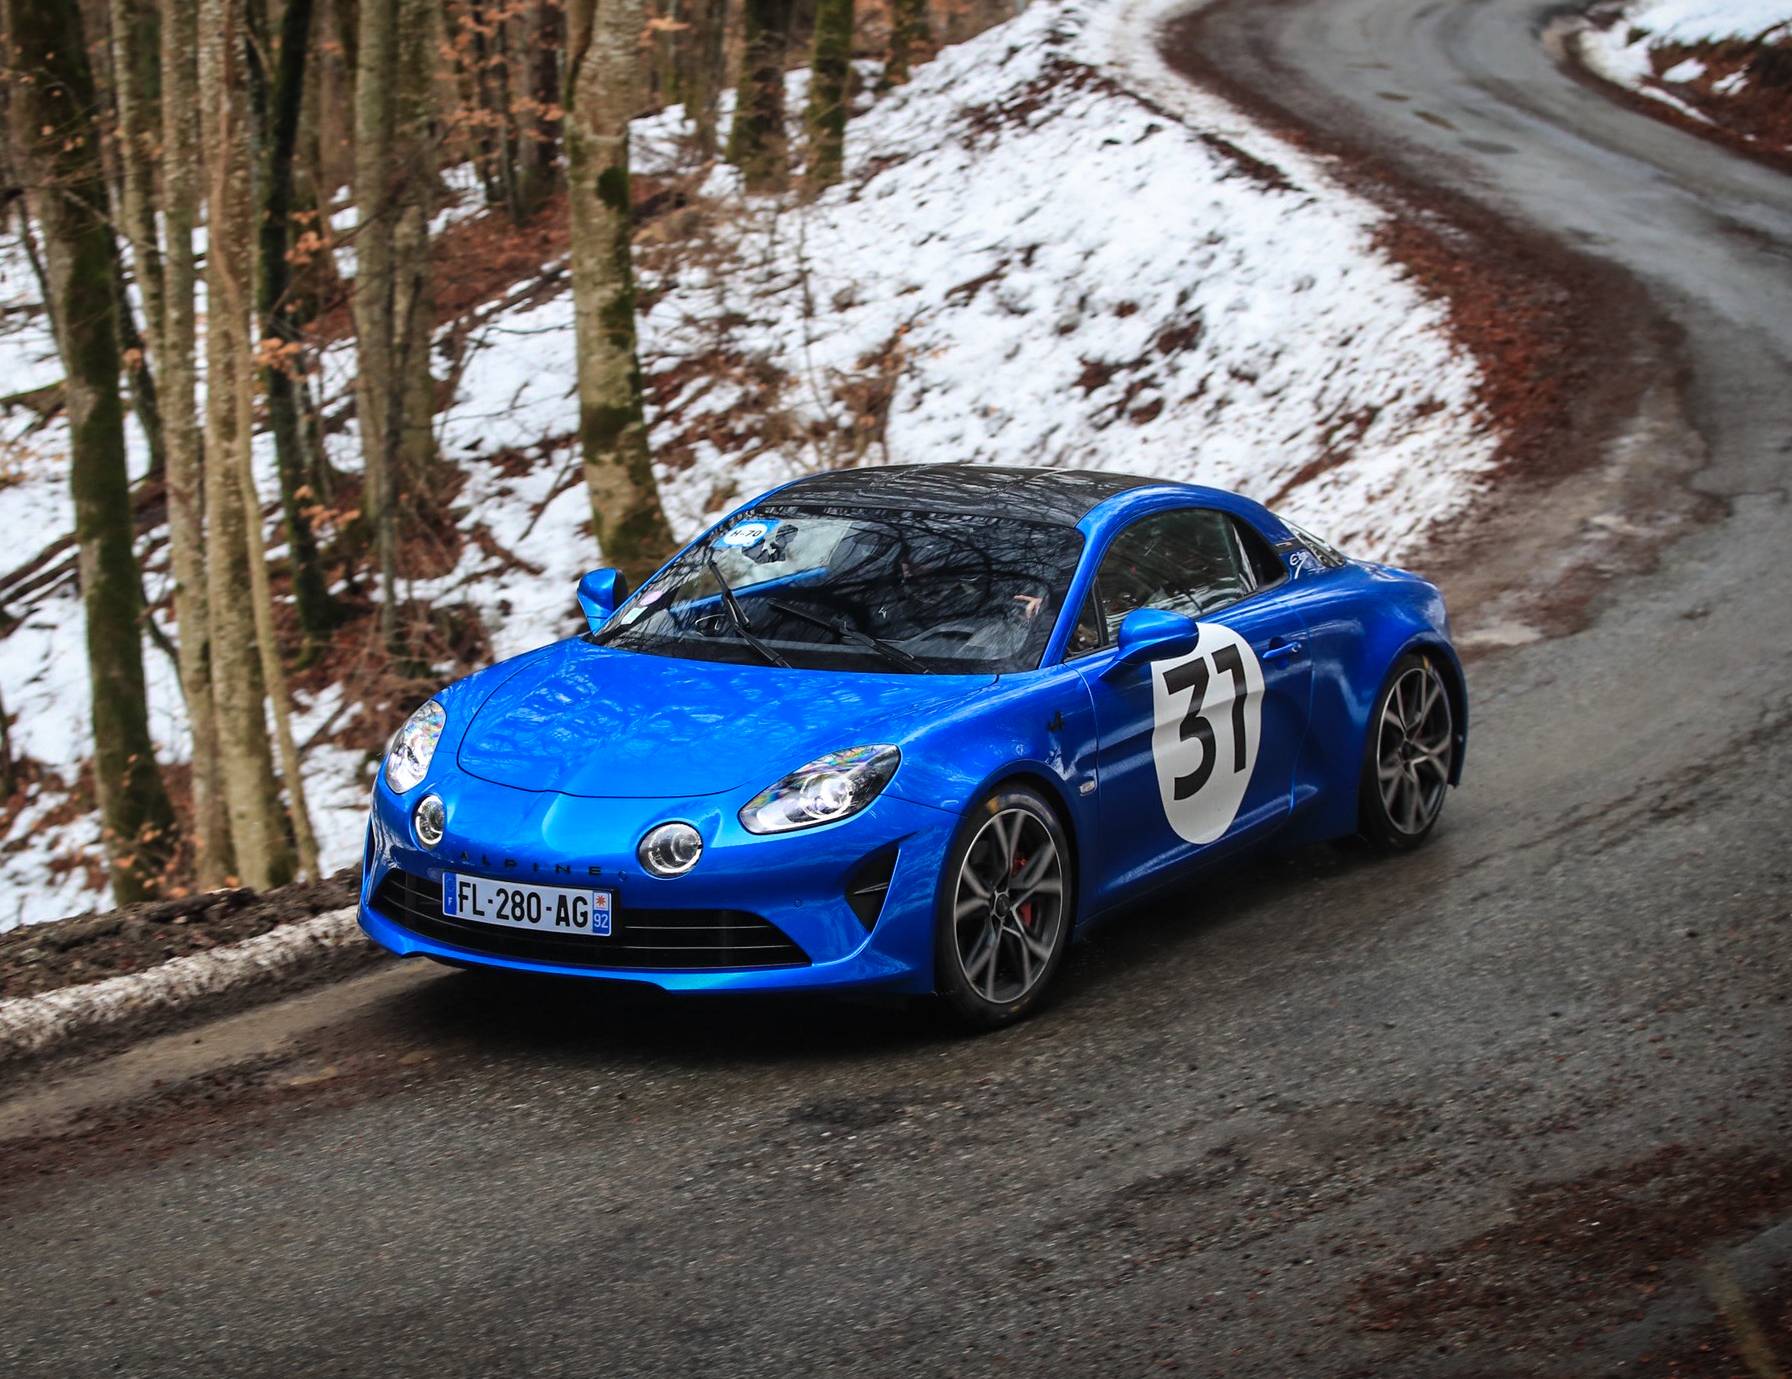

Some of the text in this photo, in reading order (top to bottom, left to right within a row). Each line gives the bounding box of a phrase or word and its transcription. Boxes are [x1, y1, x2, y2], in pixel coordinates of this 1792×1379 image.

[1162, 643, 1248, 801] 31
[460, 851, 602, 876] ALPINE
[458, 881, 588, 928] FL-280-AG
[593, 913, 609, 929] 92
